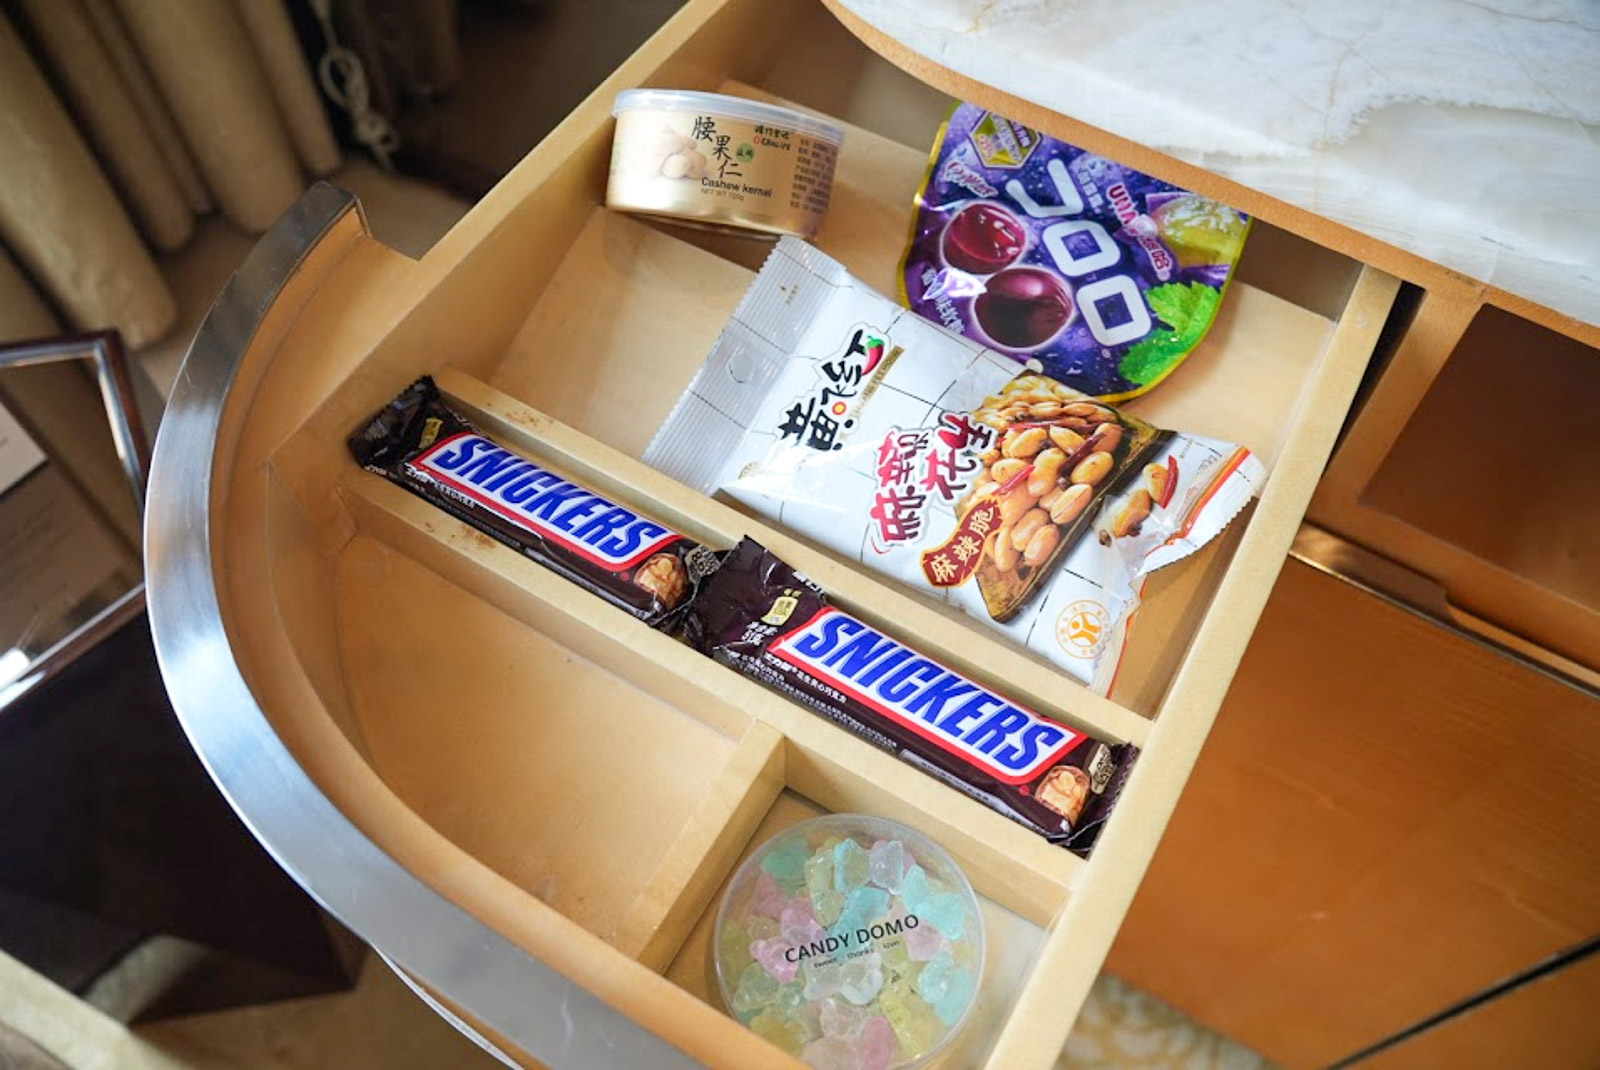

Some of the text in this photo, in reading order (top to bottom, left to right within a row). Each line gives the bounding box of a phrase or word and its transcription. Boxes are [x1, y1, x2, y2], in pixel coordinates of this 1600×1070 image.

[691, 116, 742, 179] 腰果仁
[701, 176, 773, 198] Cashew kernel
[431, 436, 668, 560] SNICKERS
[930, 502, 998, 586] 麻辣脆
[796, 611, 1068, 771] SNICKERS
[785, 913, 919, 962] CANDY DOMO
